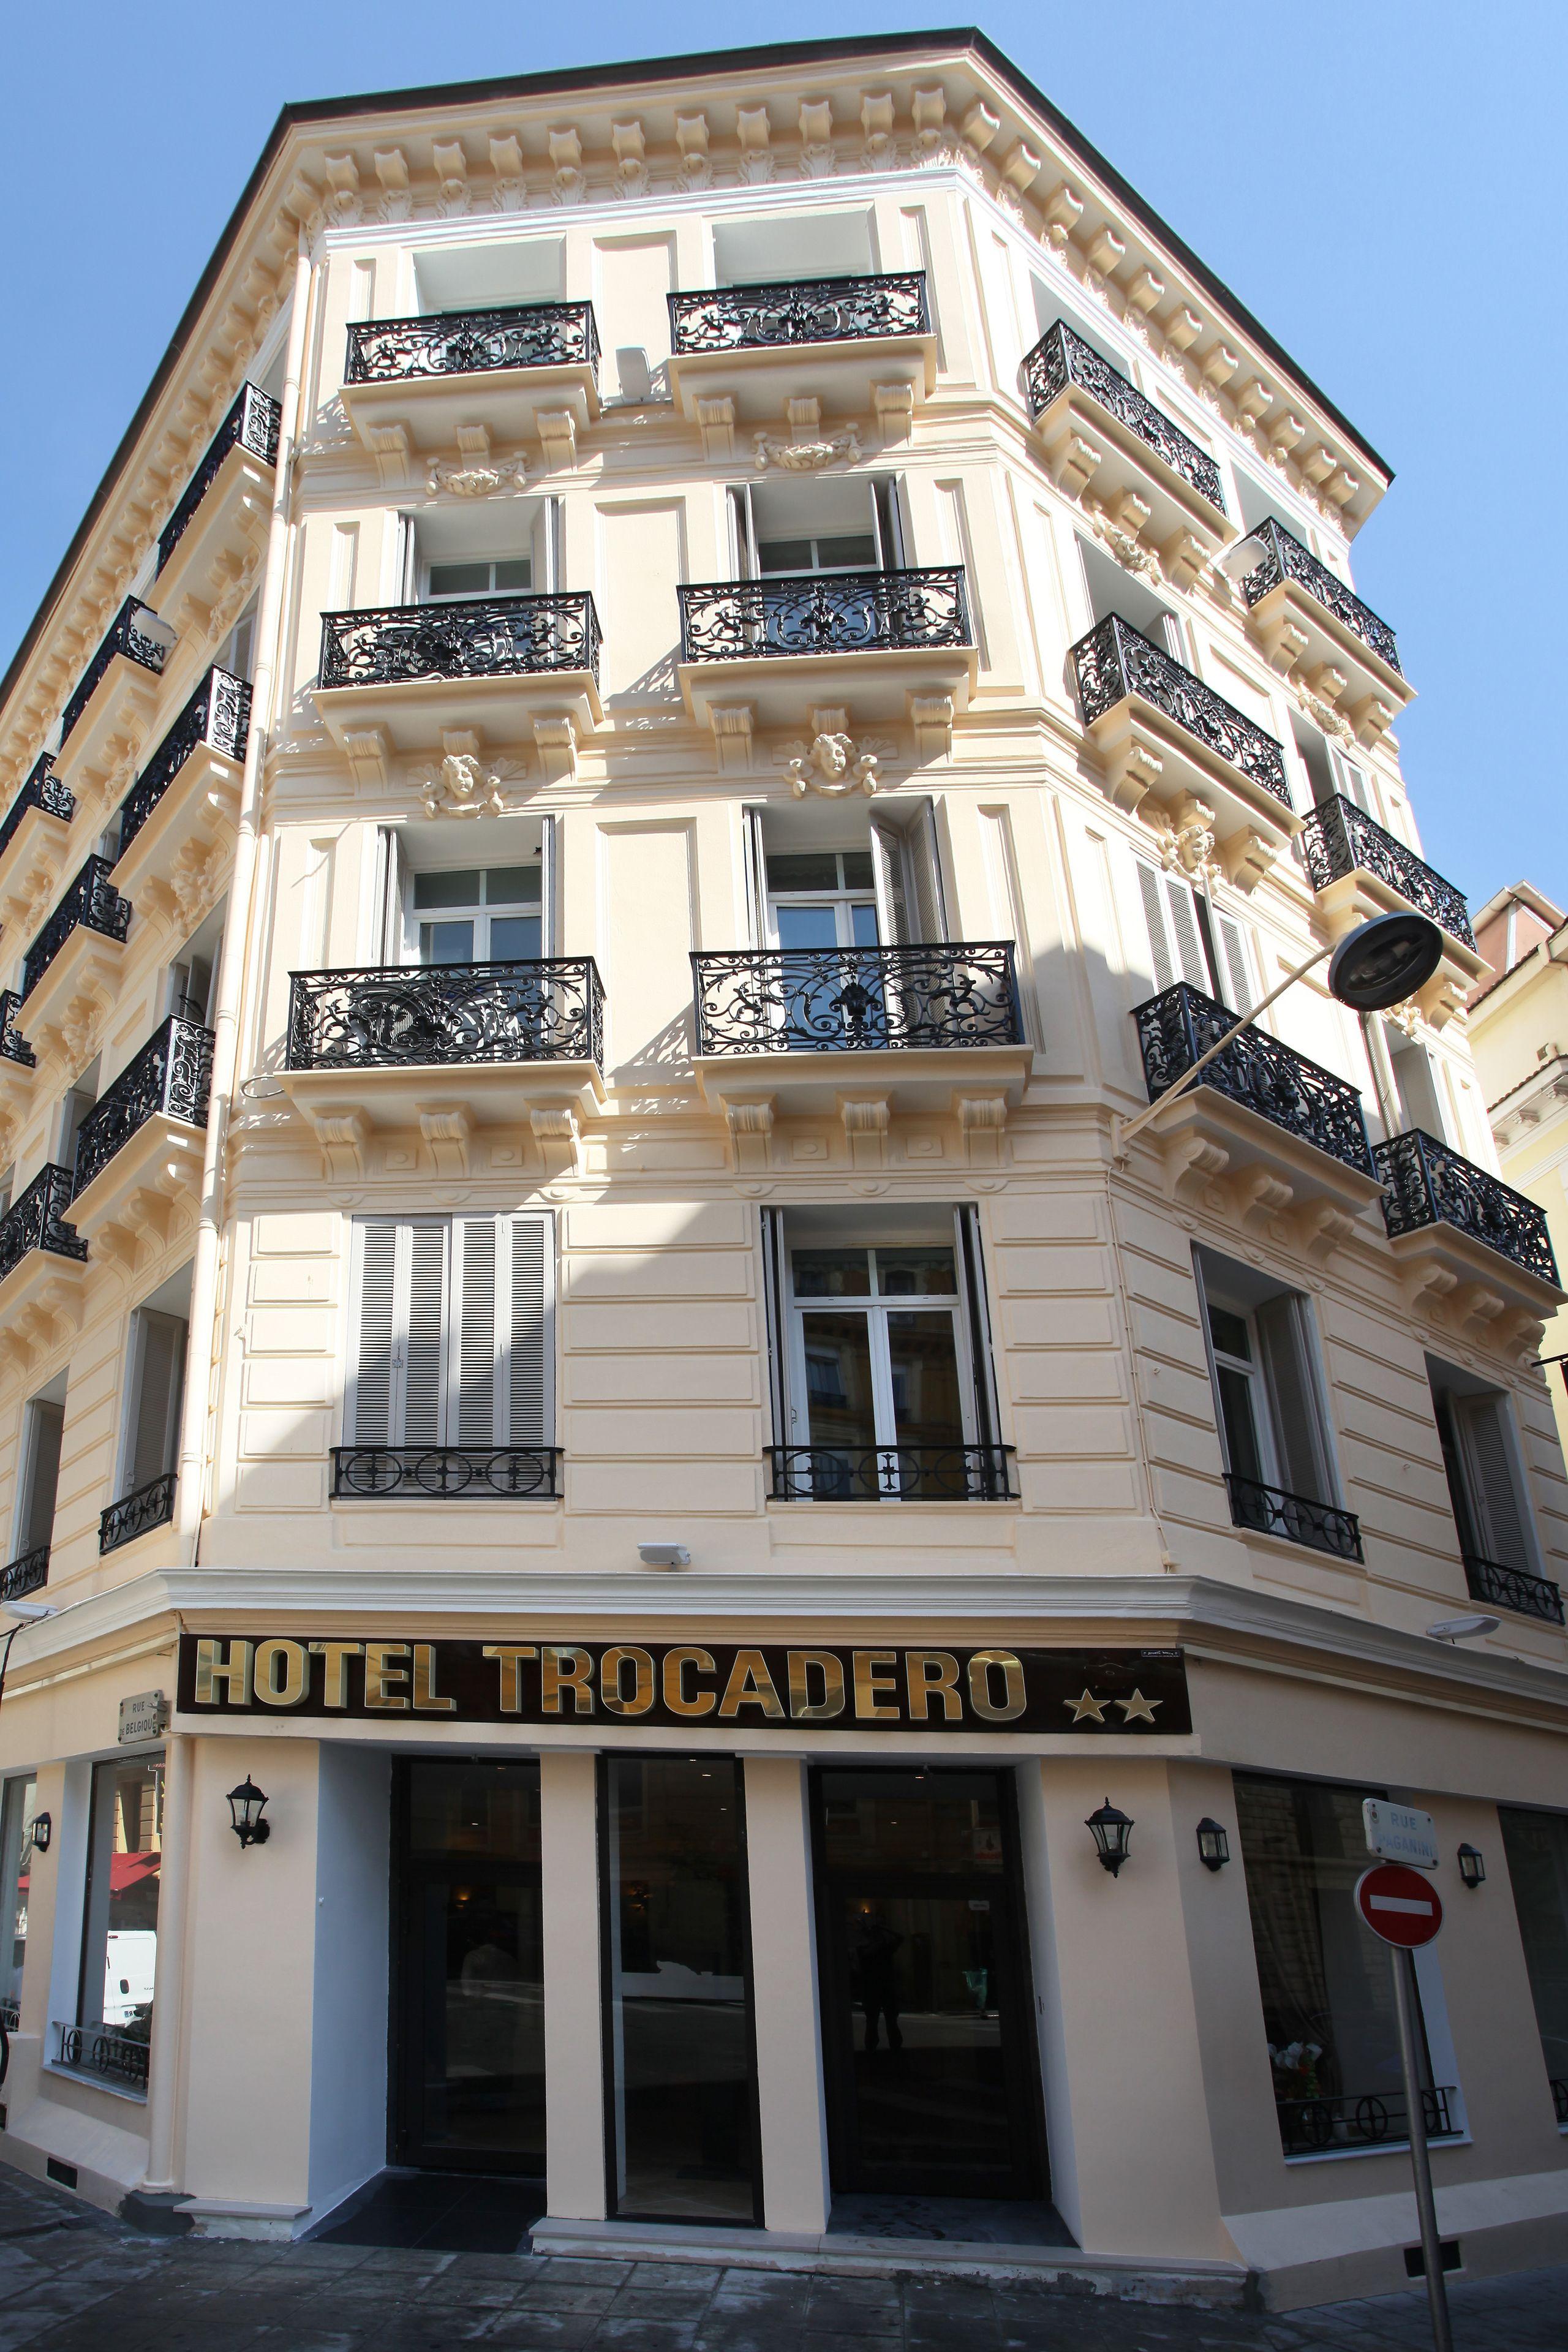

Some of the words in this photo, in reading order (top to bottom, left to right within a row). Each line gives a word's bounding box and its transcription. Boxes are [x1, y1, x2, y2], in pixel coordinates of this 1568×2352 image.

[195, 1638, 456, 1711] HOTEL
[483, 1646, 1027, 1721] TROCADERO
[133, 1701, 145, 1713] RUE
[126, 1718, 156, 1735] BELGIQUE
[1390, 1812, 1417, 1830] RUE
[1377, 1833, 1433, 1857] PAGANINI
